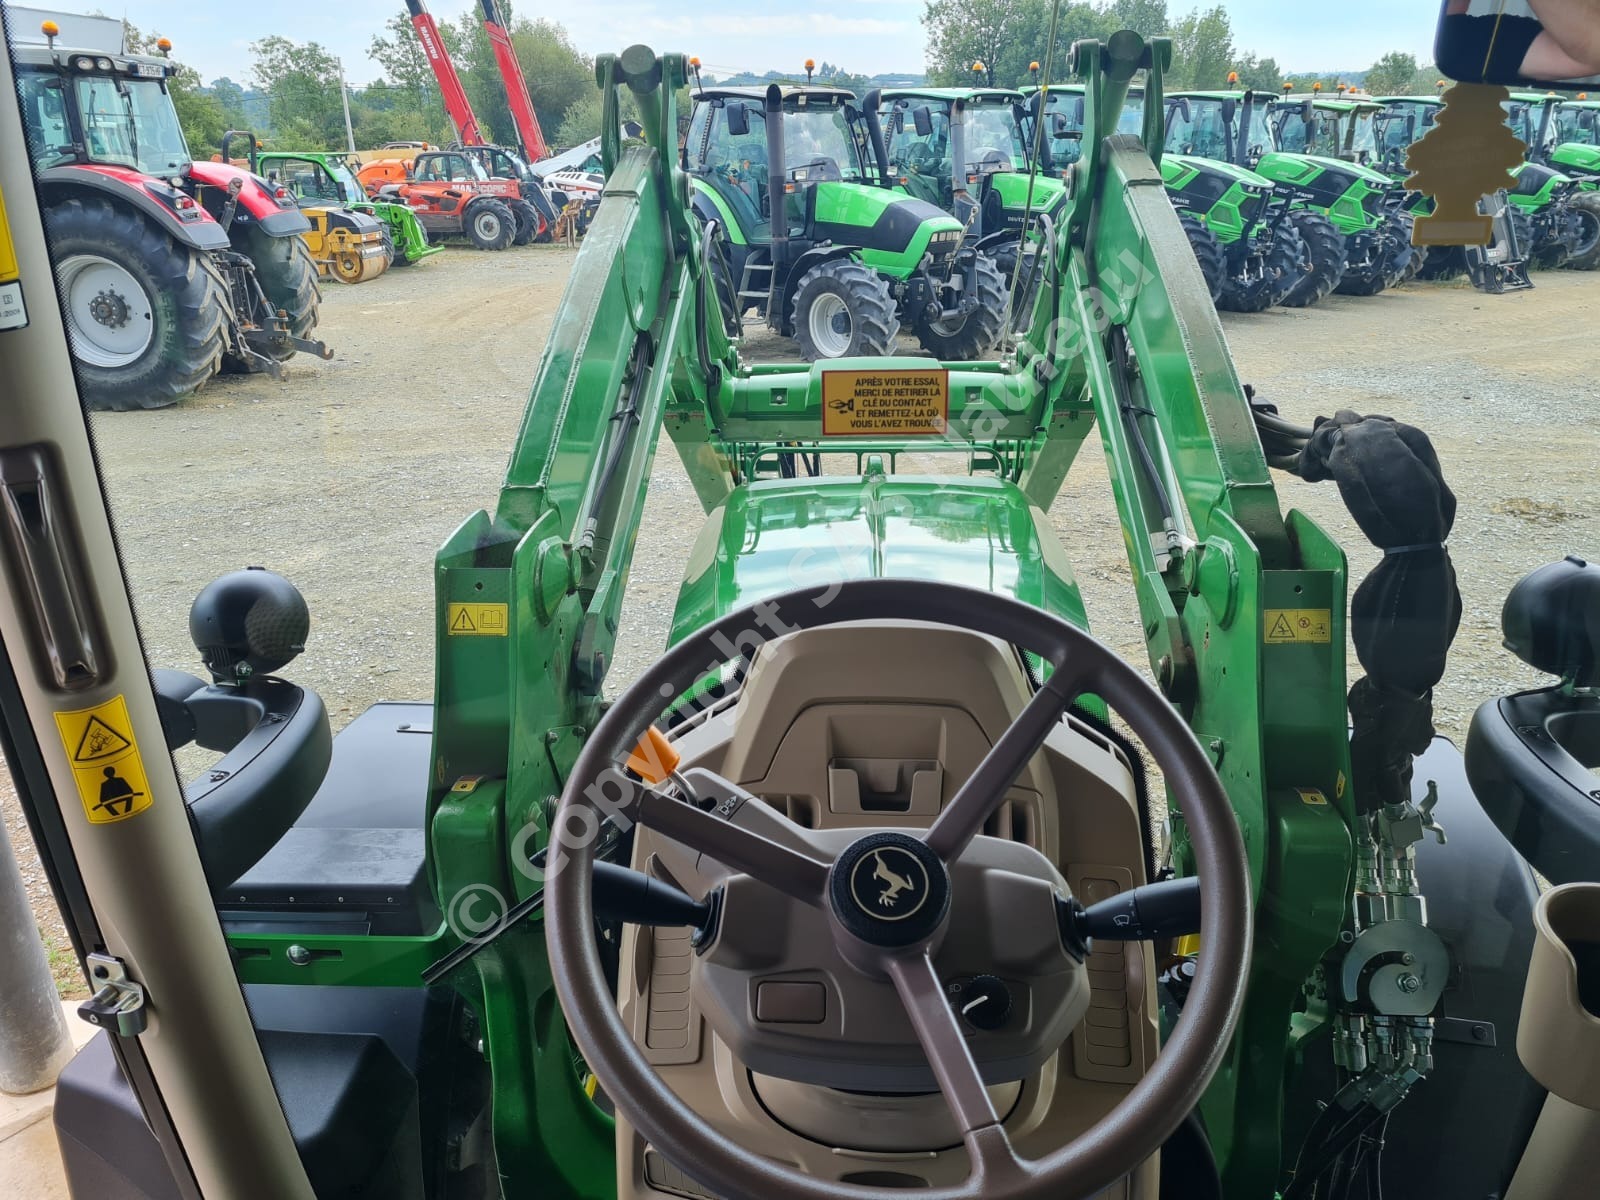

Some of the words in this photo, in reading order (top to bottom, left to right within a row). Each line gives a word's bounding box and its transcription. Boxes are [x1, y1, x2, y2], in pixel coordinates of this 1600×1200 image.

[420, 26, 439, 59] MANITOU
[451, 184, 507, 194] MANCOPIC
[855, 376, 883, 386] APRÈS
[884, 377, 912, 386] VOTRE
[854, 388, 880, 397] MERCI
[881, 388, 892, 397] DE
[893, 387, 929, 396] RETIRER
[930, 387, 941, 396] LA
[862, 397, 879, 408] CLÉ
[879, 399, 891, 408] DU
[892, 398, 932, 407] CONTACT
[856, 409, 866, 418] ET
[868, 408, 925, 418] REMETTEZ-LA
[926, 407, 939, 417] OÙ
[850, 420, 872, 429] VOUS
[874, 419, 902, 428] L'AVEZ
